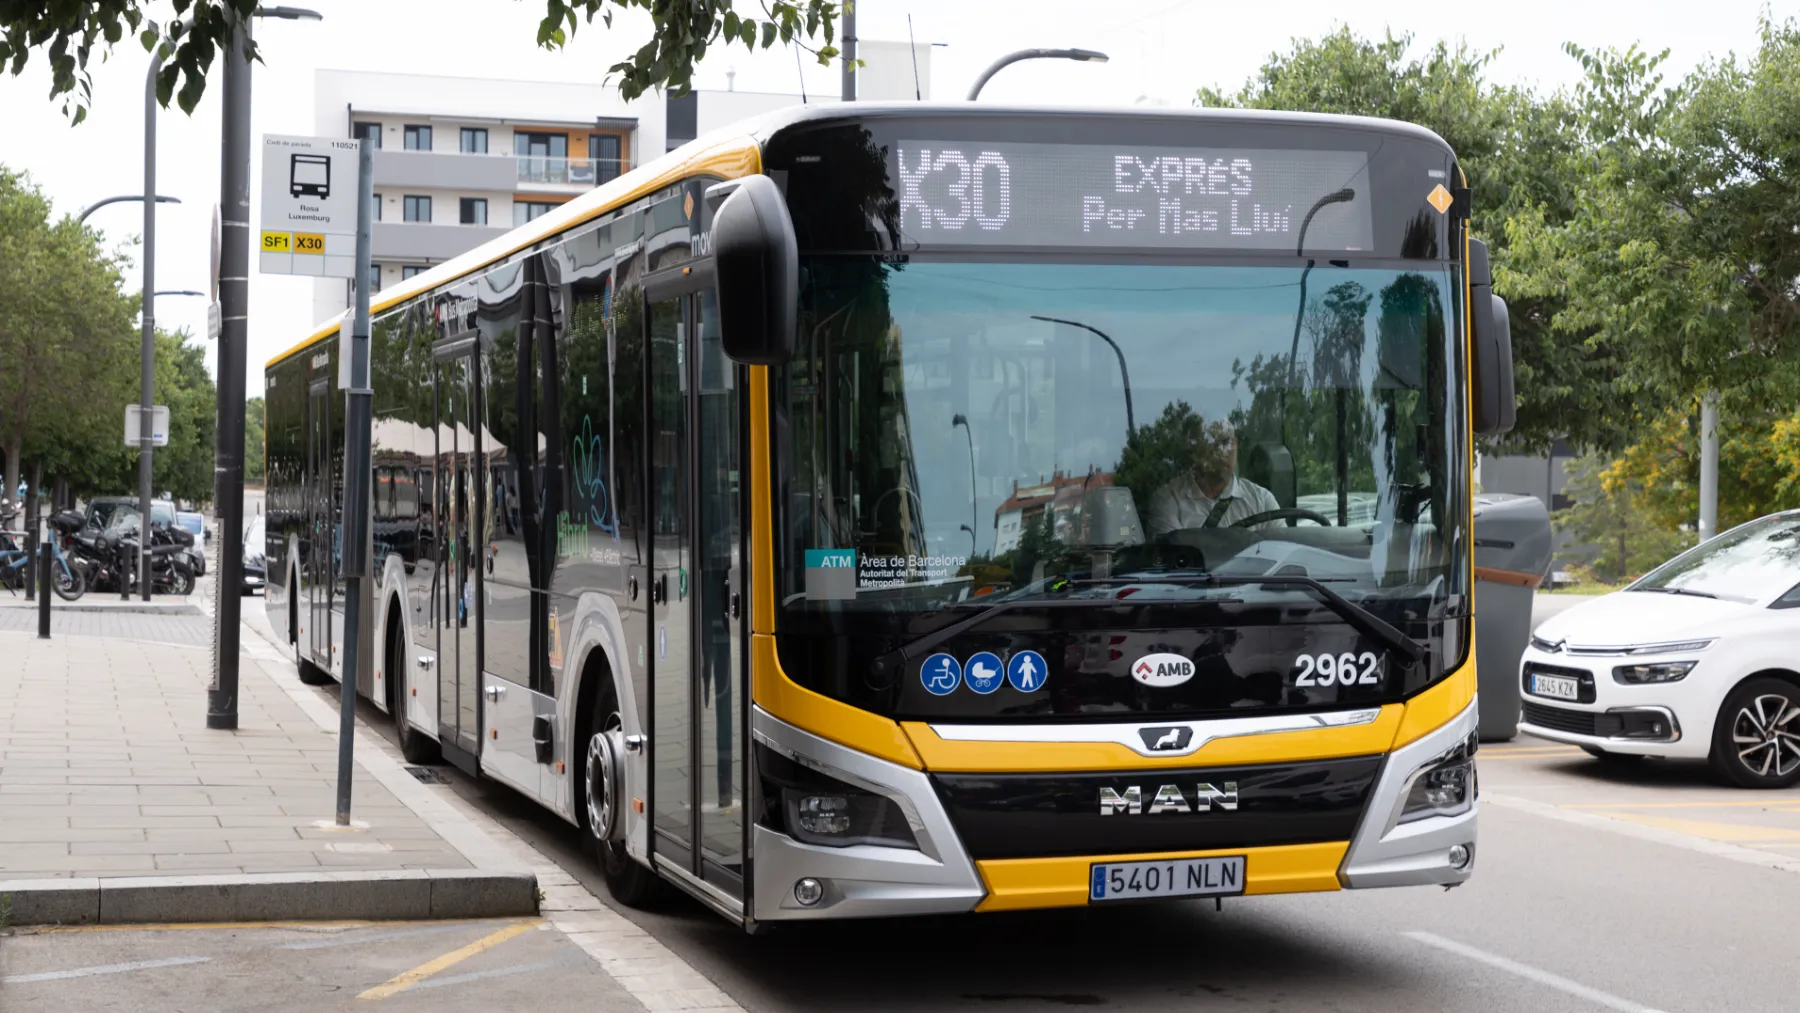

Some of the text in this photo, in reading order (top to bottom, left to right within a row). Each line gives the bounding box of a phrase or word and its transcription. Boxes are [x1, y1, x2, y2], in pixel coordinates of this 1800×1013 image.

[331, 142, 358, 150] 110521
[1115, 155, 1252, 194] EXPRÉS
[897, 149, 1009, 230] X30
[288, 213, 331, 222] Luxemburg
[1084, 195, 1146, 232] Per
[1160, 197, 1218, 234] Mas
[264, 235, 289, 248] SF1
[296, 237, 322, 250] X30
[821, 555, 851, 568] ATM
[860, 552, 966, 568] Àrea de Barcelona
[860, 568, 947, 578] Autoritat del Transport
[860, 578, 905, 588] Metropolità
[1156, 663, 1192, 677] AMB
[1295, 652, 1378, 687] 2962
[1537, 678, 1575, 697] 2645 KZK
[1100, 782, 1238, 816] MAN
[1111, 862, 1236, 893] 5401 NLN
